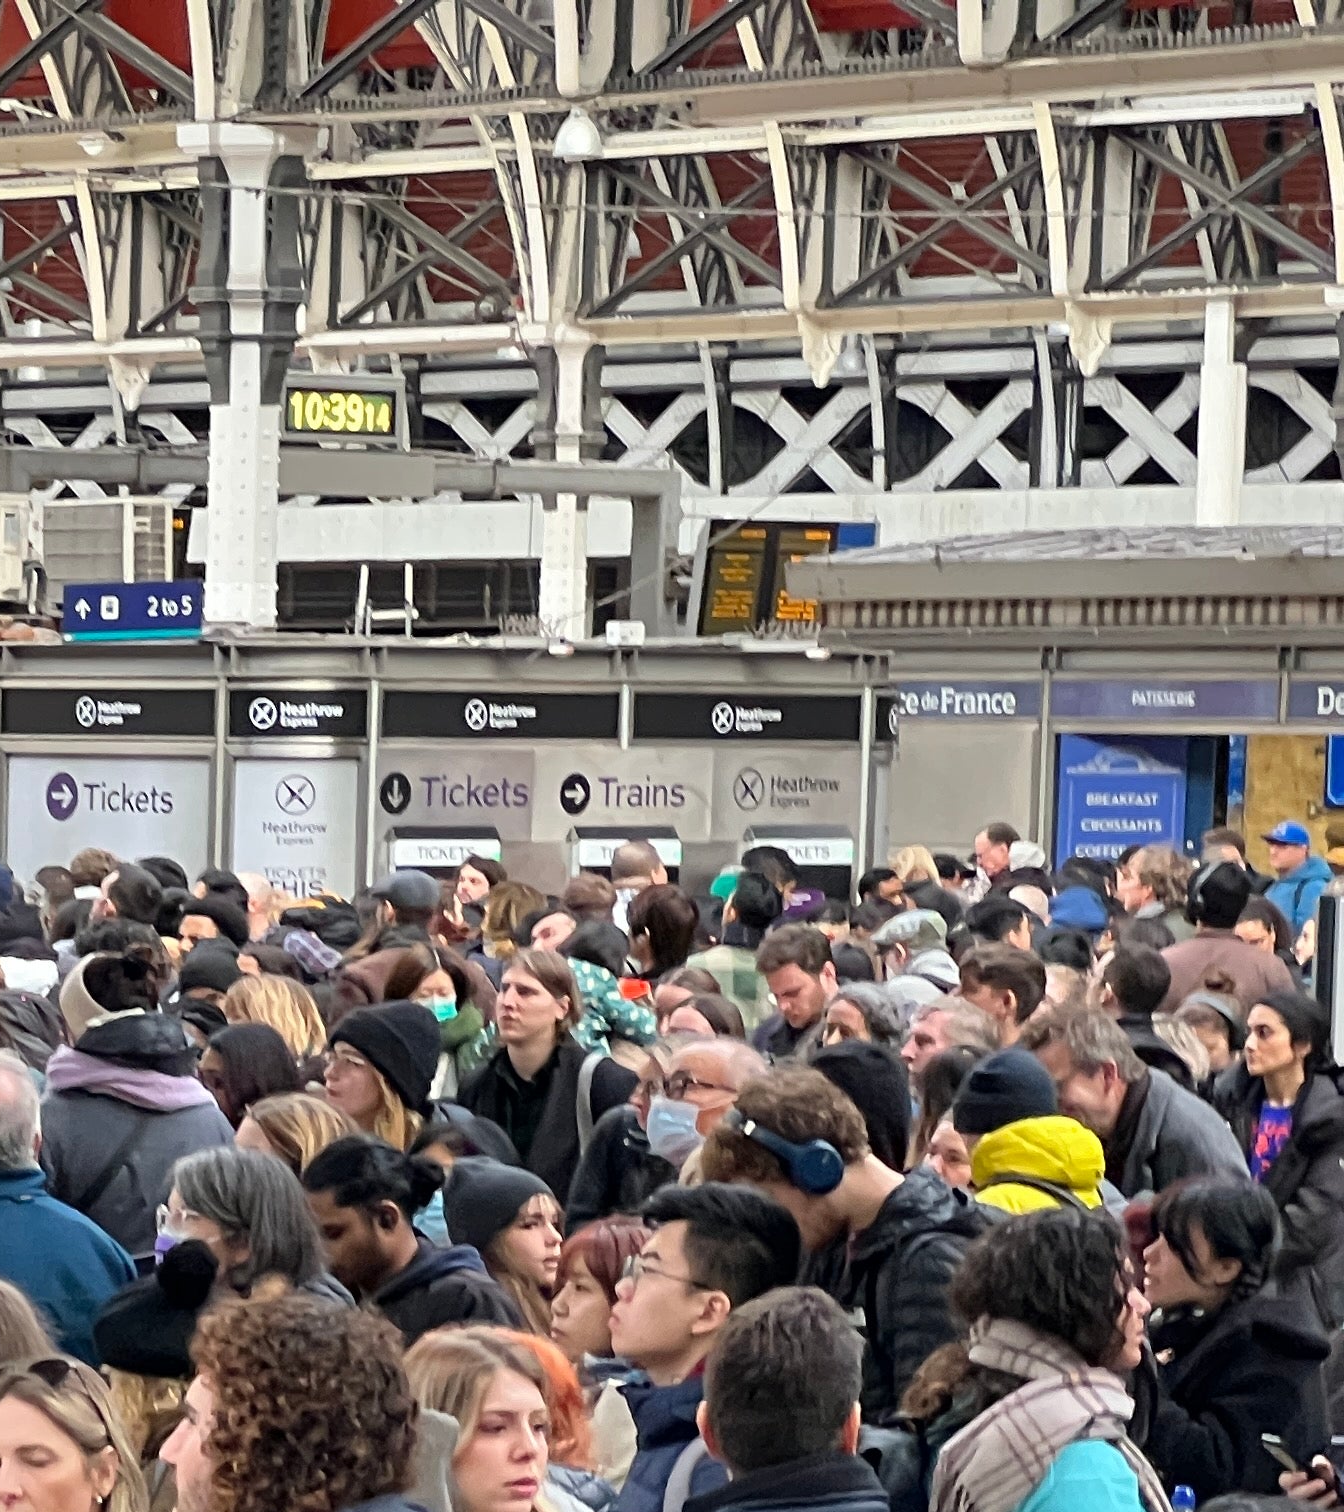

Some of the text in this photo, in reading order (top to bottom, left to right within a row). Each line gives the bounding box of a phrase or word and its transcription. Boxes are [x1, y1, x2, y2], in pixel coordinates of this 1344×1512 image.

[147, 595, 192, 616] 2 to 5
[921, 690, 938, 711] de
[940, 686, 1016, 715] France
[1131, 690, 1196, 708] PATISSERIE
[279, 702, 343, 718] Heathrow
[279, 715, 318, 728] Express
[420, 776, 528, 807] Tickets
[599, 775, 685, 808] Trains
[770, 774, 840, 793] Heathrow
[83, 782, 173, 815] Tickets
[1086, 792, 1158, 806] BREAKFAST
[262, 821, 327, 833] Heathrow
[1080, 818, 1162, 832] CROISSANTS
[417, 846, 475, 860] TICKETS
[264, 866, 326, 881] TICKETS
